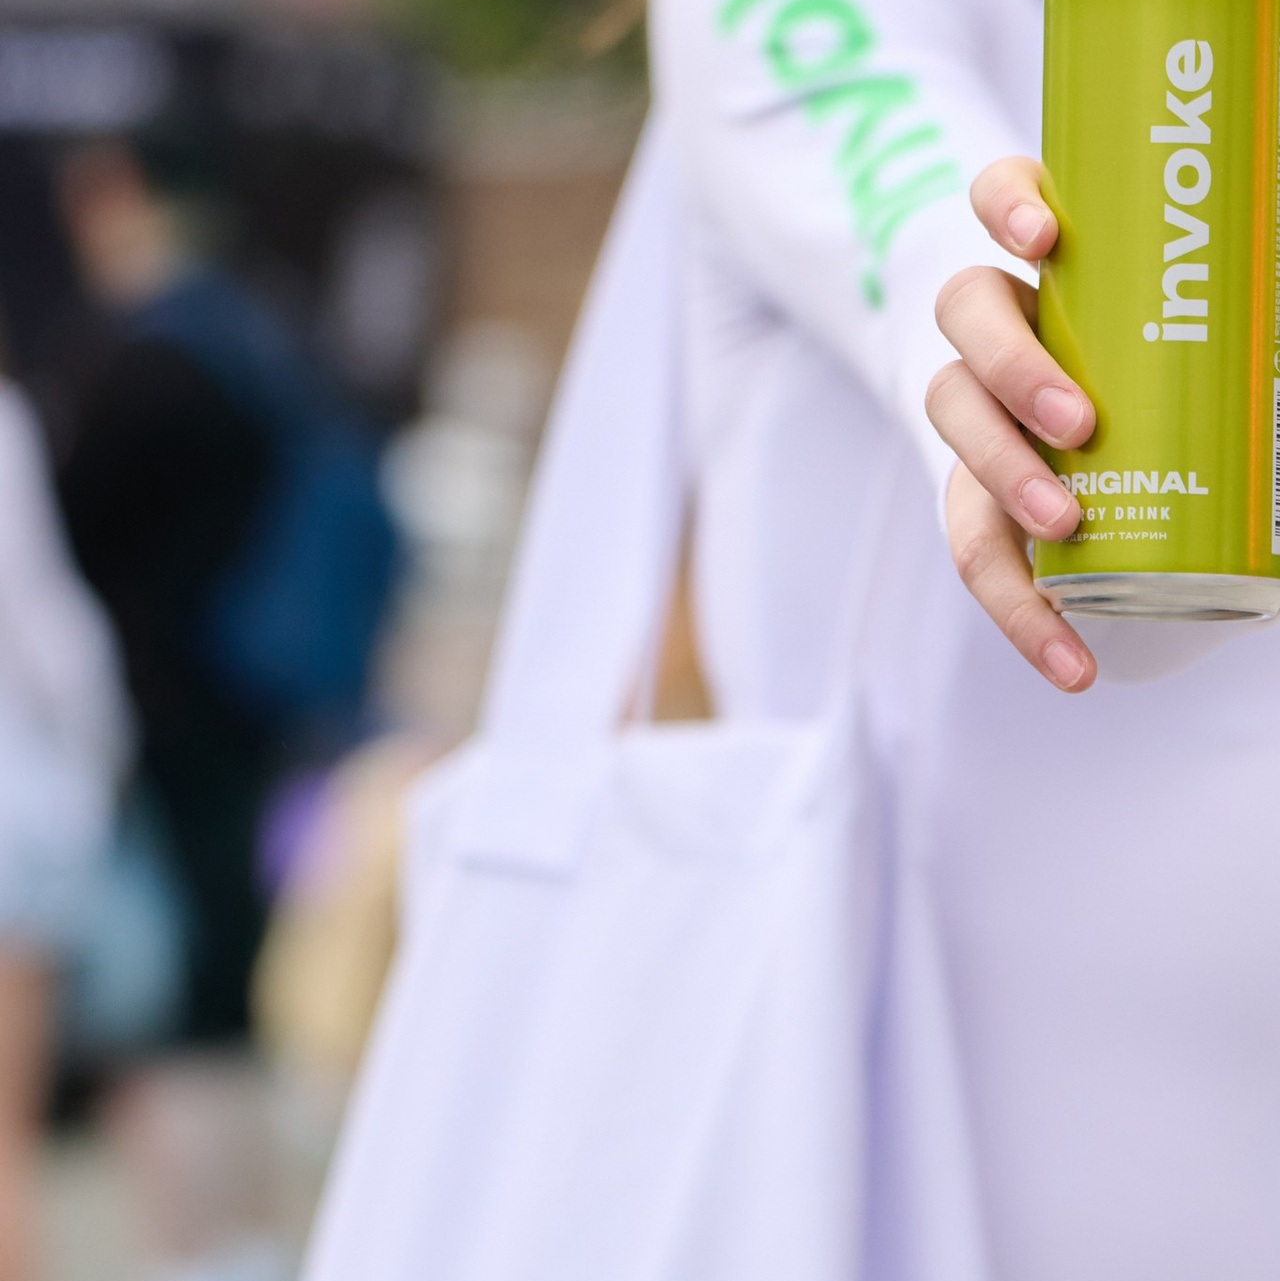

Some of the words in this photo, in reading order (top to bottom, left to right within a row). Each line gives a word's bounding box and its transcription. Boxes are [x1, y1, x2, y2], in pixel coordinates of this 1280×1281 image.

[1142, 38, 1214, 343] invoke
[1114, 506, 1171, 521] DRINK
[1059, 532, 1116, 543] ОДЕРЖИТ
[1118, 531, 1168, 541] ТАУРИН
